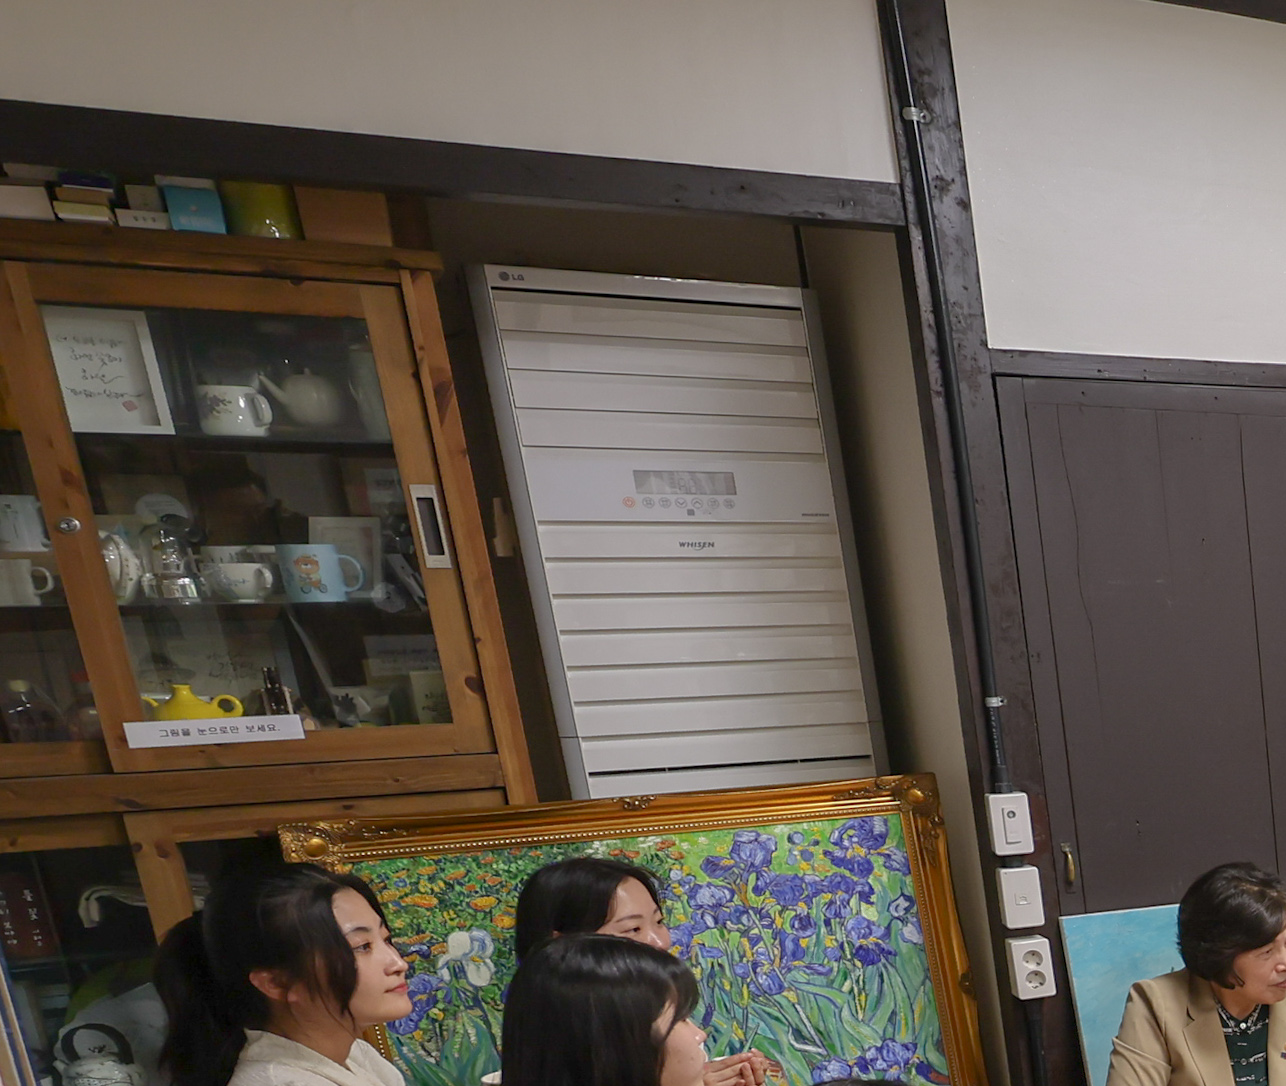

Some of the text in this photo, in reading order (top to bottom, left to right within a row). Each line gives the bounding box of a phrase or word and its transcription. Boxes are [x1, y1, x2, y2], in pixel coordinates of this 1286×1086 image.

[511, 273, 525, 281] LG
[678, 541, 715, 551] WHISEN
[159, 723, 281, 738] 그림을 눈으로만 보세요.
